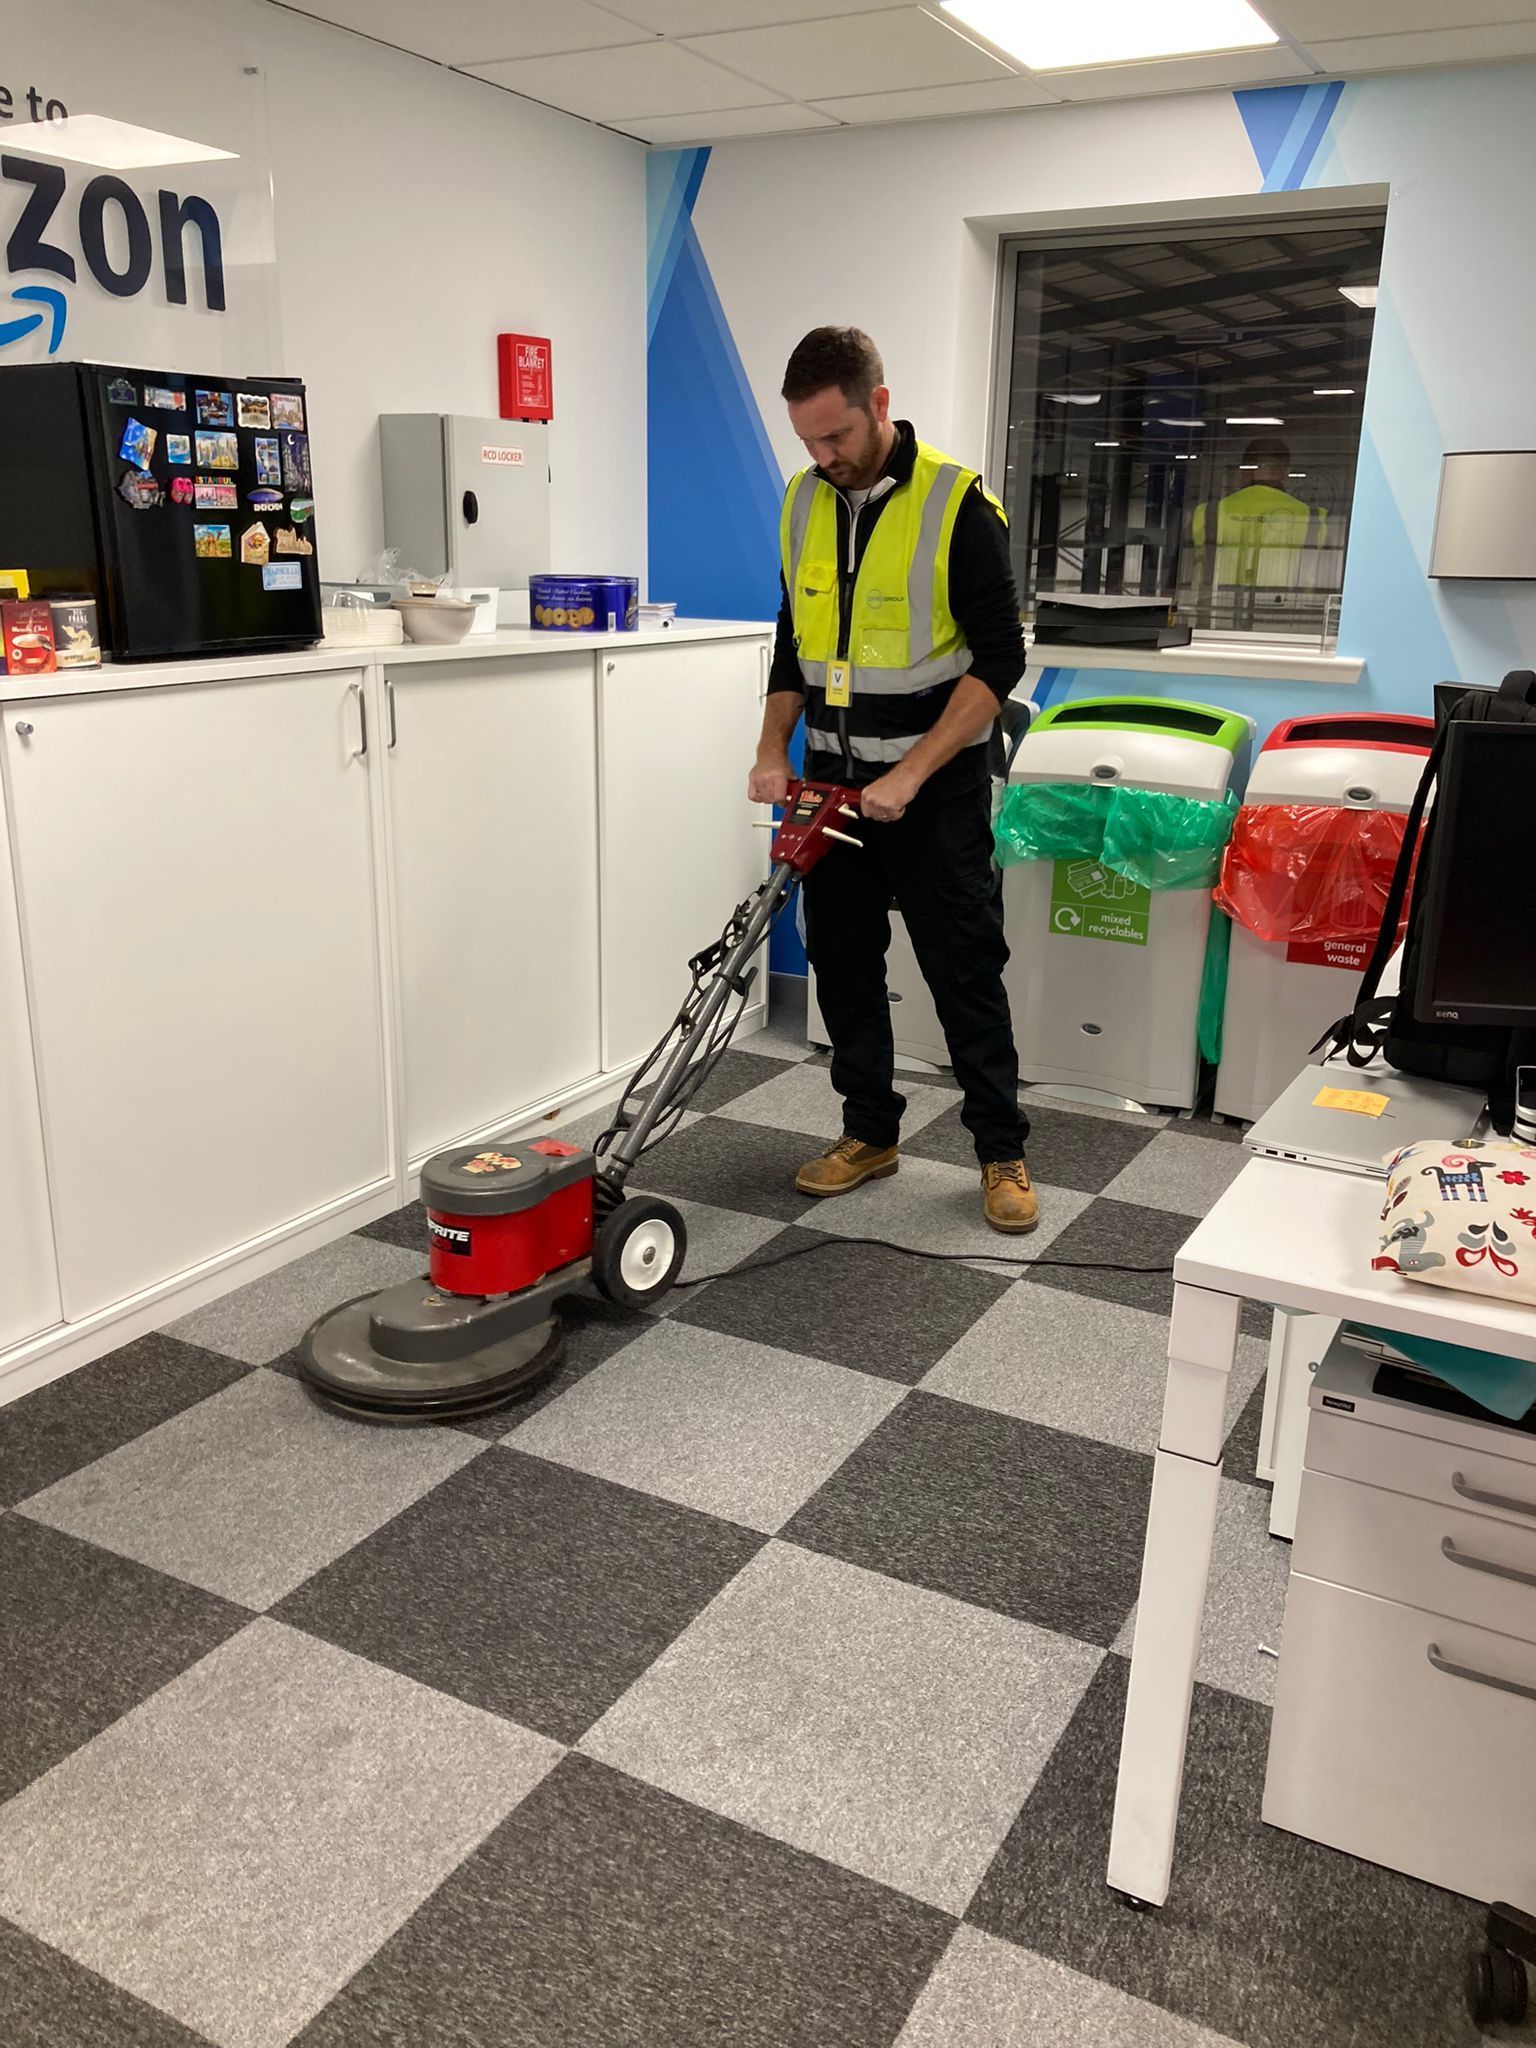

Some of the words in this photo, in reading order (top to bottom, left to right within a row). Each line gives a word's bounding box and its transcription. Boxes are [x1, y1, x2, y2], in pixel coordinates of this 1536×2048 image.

[26, 86, 69, 130] to
[525, 346, 538, 358] FIRE
[518, 355, 545, 369] BLANKET
[483, 450, 497, 460] RCD
[498, 451, 522, 461] LOCKER
[834, 672, 842, 684] V
[1101, 912, 1131, 926] mixed
[1088, 925, 1144, 941] recyclables
[1324, 941, 1367, 954] general
[1327, 954, 1361, 966] waste
